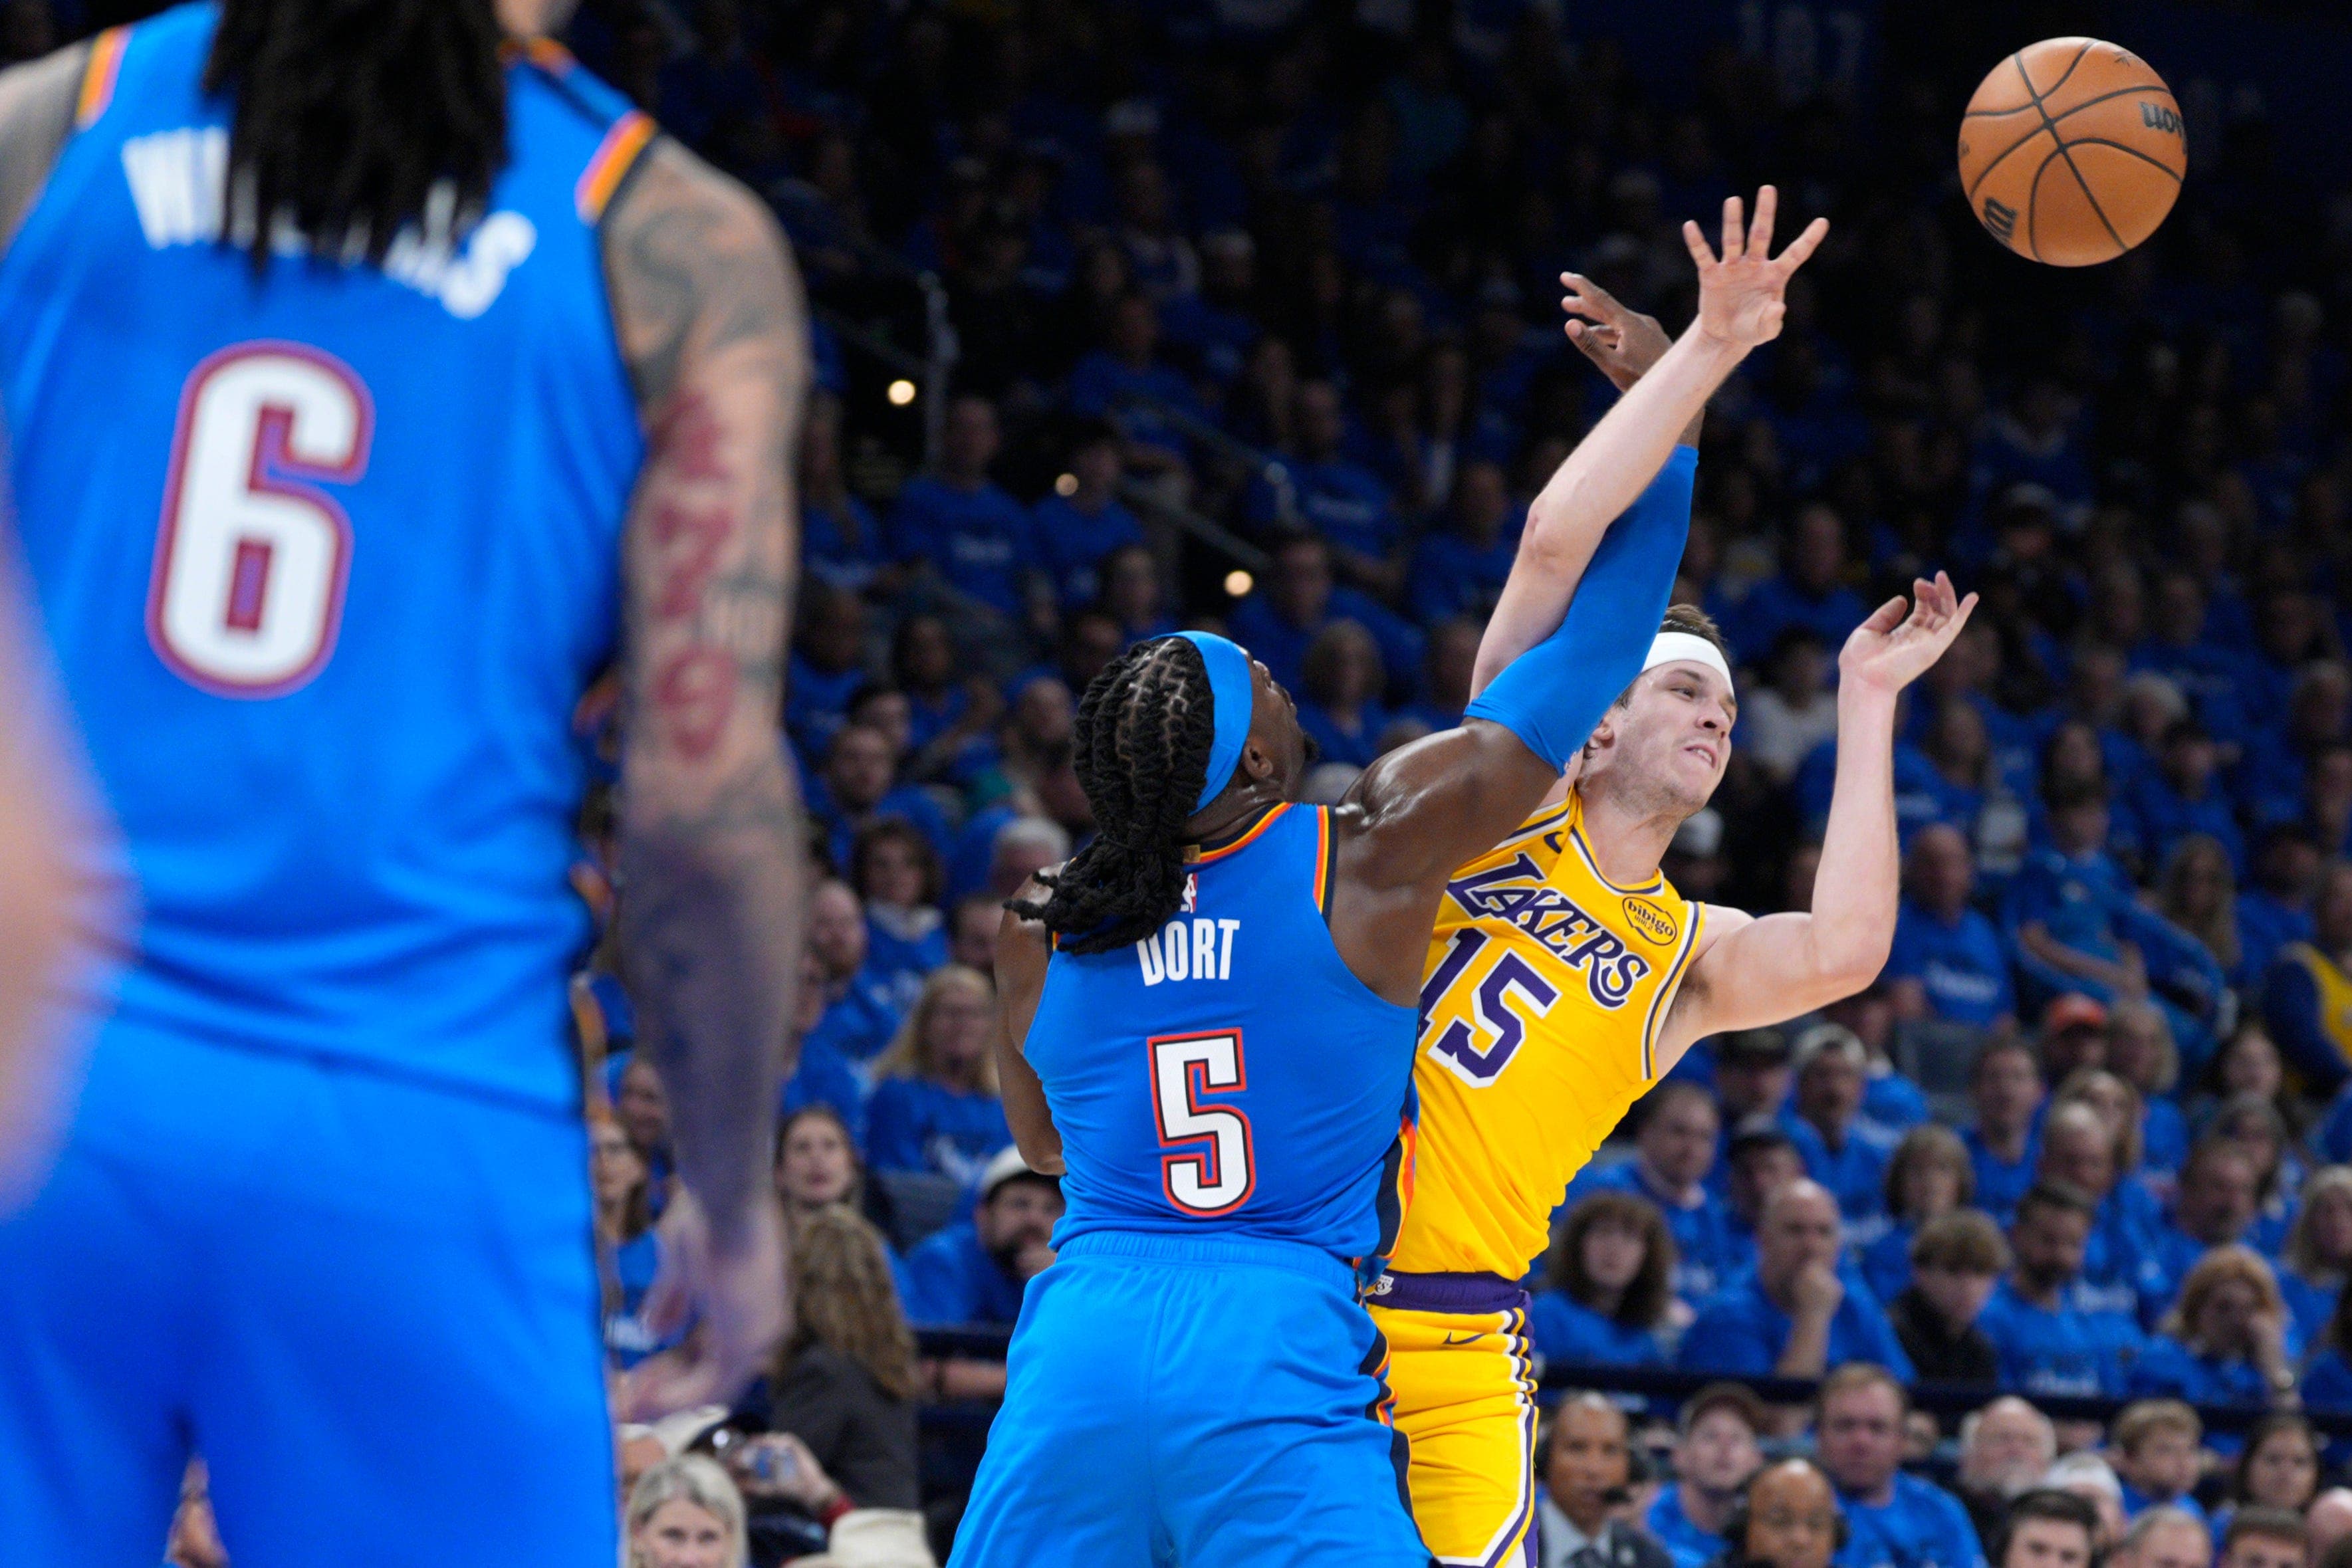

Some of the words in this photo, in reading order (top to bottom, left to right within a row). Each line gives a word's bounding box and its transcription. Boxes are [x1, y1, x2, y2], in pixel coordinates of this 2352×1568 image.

[145, 339, 377, 701] 6
[1136, 918, 1240, 987] DORT
[1445, 850, 1651, 1010] LAKERS
[1628, 900, 1673, 937] bibigo
[1418, 927, 1563, 1089] 15
[1147, 1027, 1256, 1217] 5
